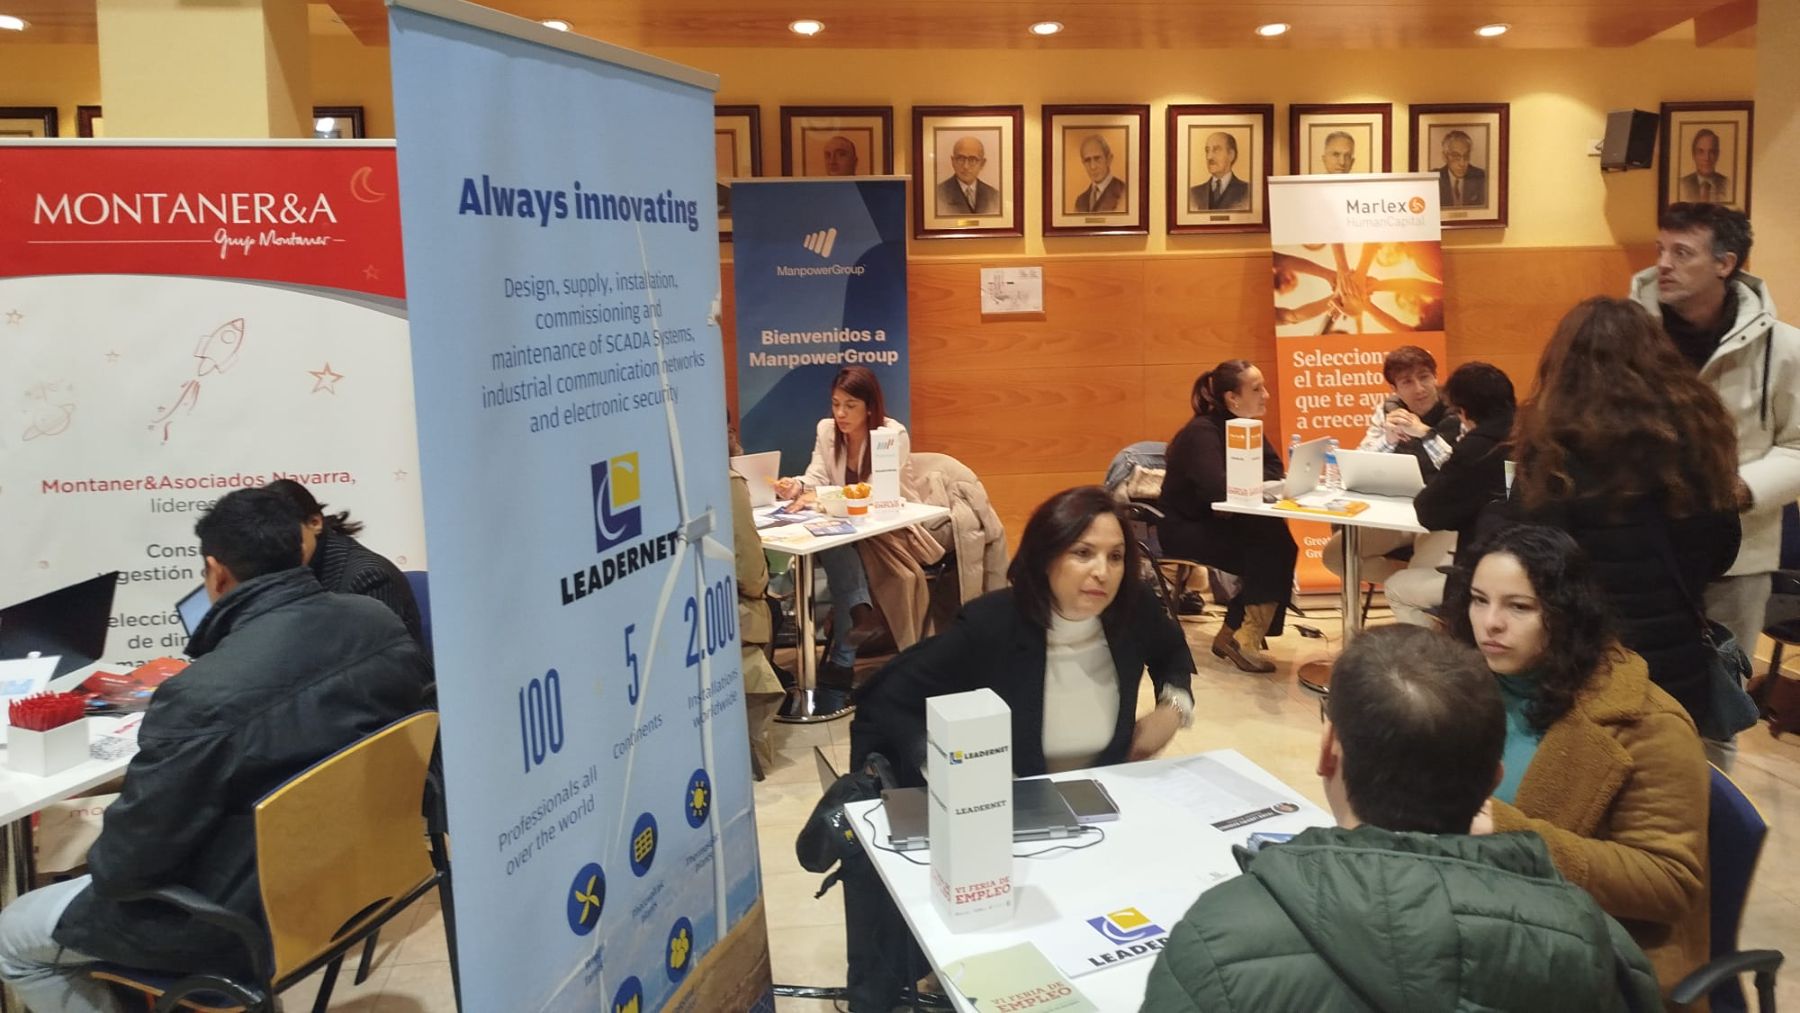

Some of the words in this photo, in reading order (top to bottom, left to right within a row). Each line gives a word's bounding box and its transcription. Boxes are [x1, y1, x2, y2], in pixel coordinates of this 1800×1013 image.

[33, 192, 337, 225] MONTANER&A
[458, 174, 569, 228] Always
[574, 180, 700, 232] innovating
[1346, 199, 1407, 214] Marlex
[1346, 215, 1425, 228] HumanCapital
[259, 229, 331, 246] Montaner
[777, 264, 865, 277] ManpowerGroup
[504, 276, 560, 301] Design,
[563, 272, 613, 297] supply,
[616, 271, 679, 292] installation,
[535, 301, 641, 331] commissioning
[643, 299, 663, 319] and
[761, 328, 871, 345] Bienvenidos
[875, 329, 886, 342] a
[491, 342, 587, 371] maintenance
[590, 334, 603, 356] of
[606, 331, 651, 353] SCADA
[653, 325, 696, 350] Systems,
[749, 348, 898, 369] ManpowerGroup
[1293, 348, 1390, 368] Seleccion
[481, 374, 552, 409] industrial
[556, 358, 660, 396] communication
[661, 351, 706, 374] networks
[1294, 370, 1312, 388] el
[1316, 369, 1383, 387] talento
[530, 405, 560, 434] and
[564, 391, 630, 425] electronic
[633, 383, 679, 410] security
[1295, 394, 1331, 413] que
[1335, 392, 1355, 407] te
[1296, 417, 1308, 429] a
[1312, 414, 1372, 429] crecer
[41, 473, 264, 494] Montaner&Asociados
[146, 543, 202, 558] Cons
[115, 565, 193, 585] gestión
[560, 530, 679, 606] LEADERNET
[107, 611, 181, 628] elecció
[684, 574, 735, 668] 2.000
[127, 635, 154, 649] de
[160, 633, 190, 648] dir
[624, 623, 640, 706] 5
[519, 667, 564, 774] 100
[612, 712, 664, 760] Continents
[964, 746, 1009, 760] LEADERNET
[498, 779, 581, 853] Professionals
[581, 764, 598, 791] all
[955, 800, 1007, 816] LEADERNET
[505, 845, 534, 877] over
[536, 823, 557, 850] the
[558, 794, 596, 832] world
[955, 883, 1010, 905] EMPLEO
[969, 879, 996, 892] FERIA
[995, 986, 1072, 1013] EMPLEO
[1008, 987, 1046, 1001] FERIA
